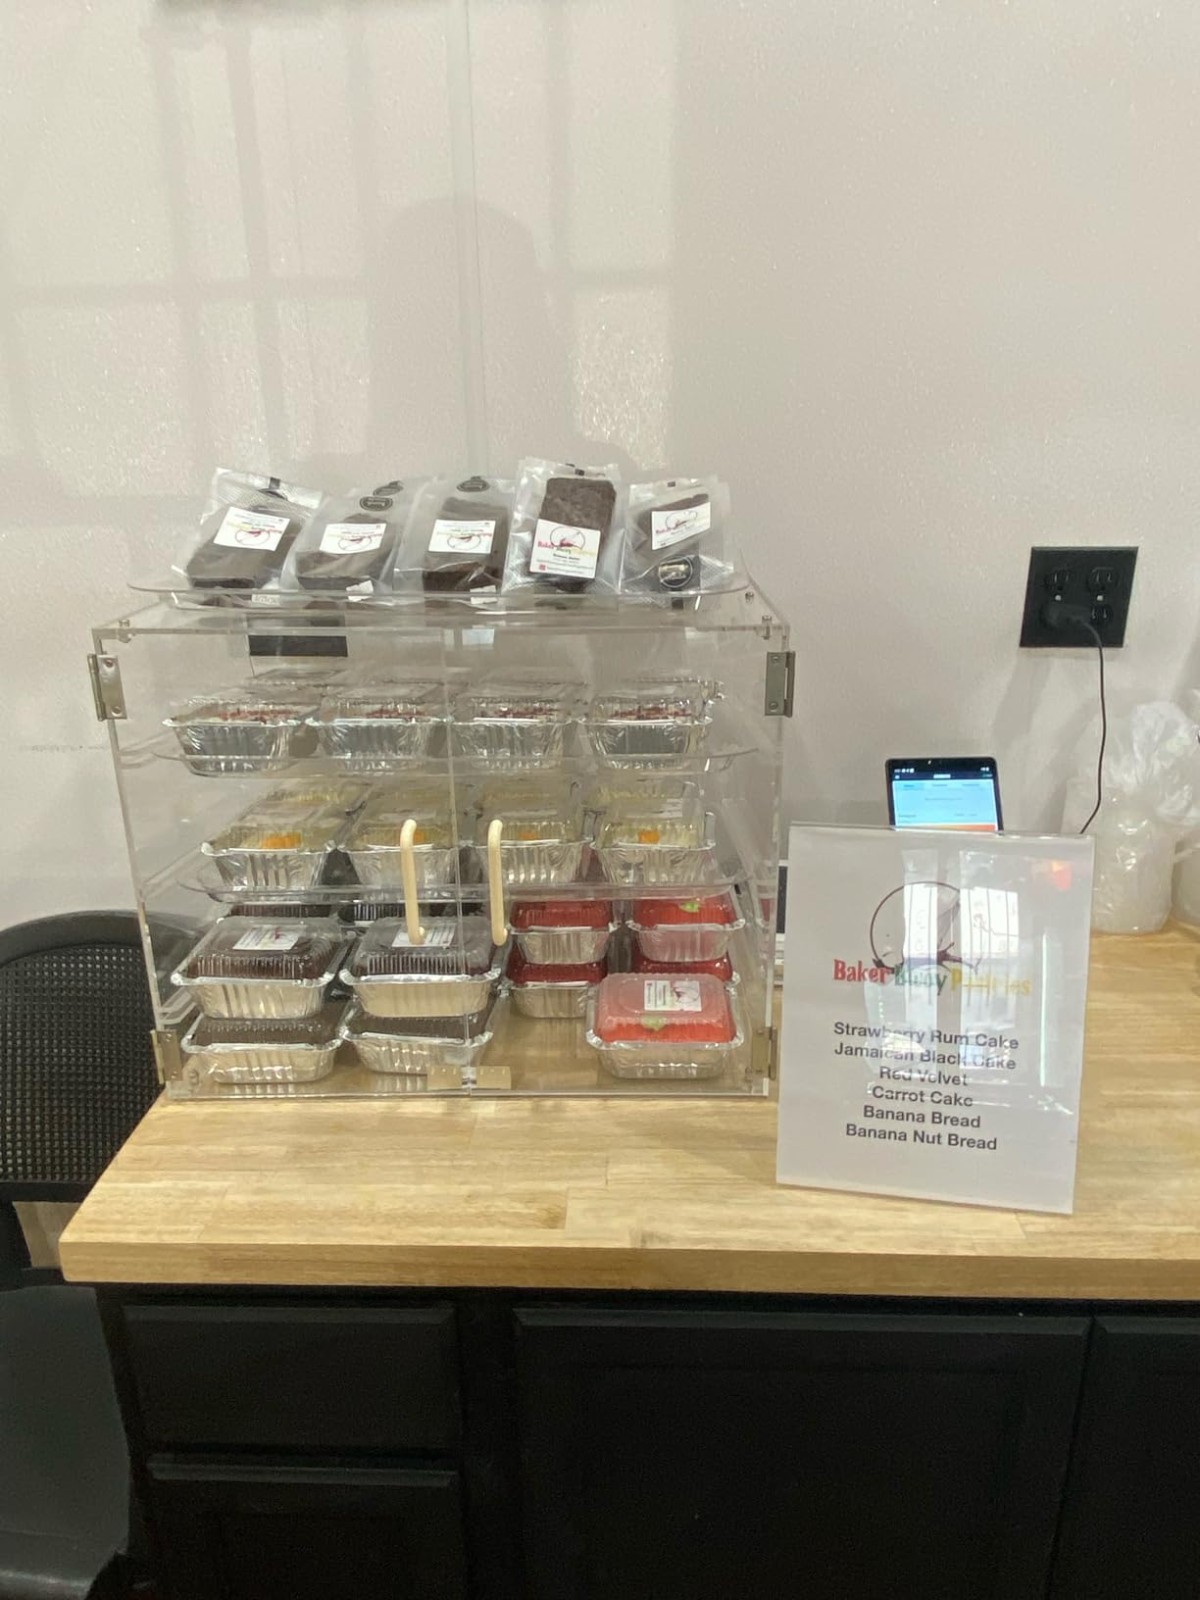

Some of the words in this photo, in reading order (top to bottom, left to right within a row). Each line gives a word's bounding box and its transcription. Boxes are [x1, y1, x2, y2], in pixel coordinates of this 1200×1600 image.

[833, 959, 890, 985] Baker
[930, 1030, 969, 1045] Rum
[975, 1033, 1019, 1049] Cake
[834, 1043, 914, 1061] Jamaican
[920, 1049, 966, 1066] Black
[973, 1055, 1016, 1070] Cake
[880, 1066, 912, 1081] Red
[918, 1069, 968, 1086] Velvet
[872, 1085, 925, 1103] Carrot
[930, 1090, 974, 1107] Cake
[863, 1105, 926, 1123] Banana
[931, 1111, 981, 1128] Bread
[846, 1123, 907, 1141] Banana
[913, 1130, 942, 1145] Nut
[948, 1133, 997, 1150] Bread
